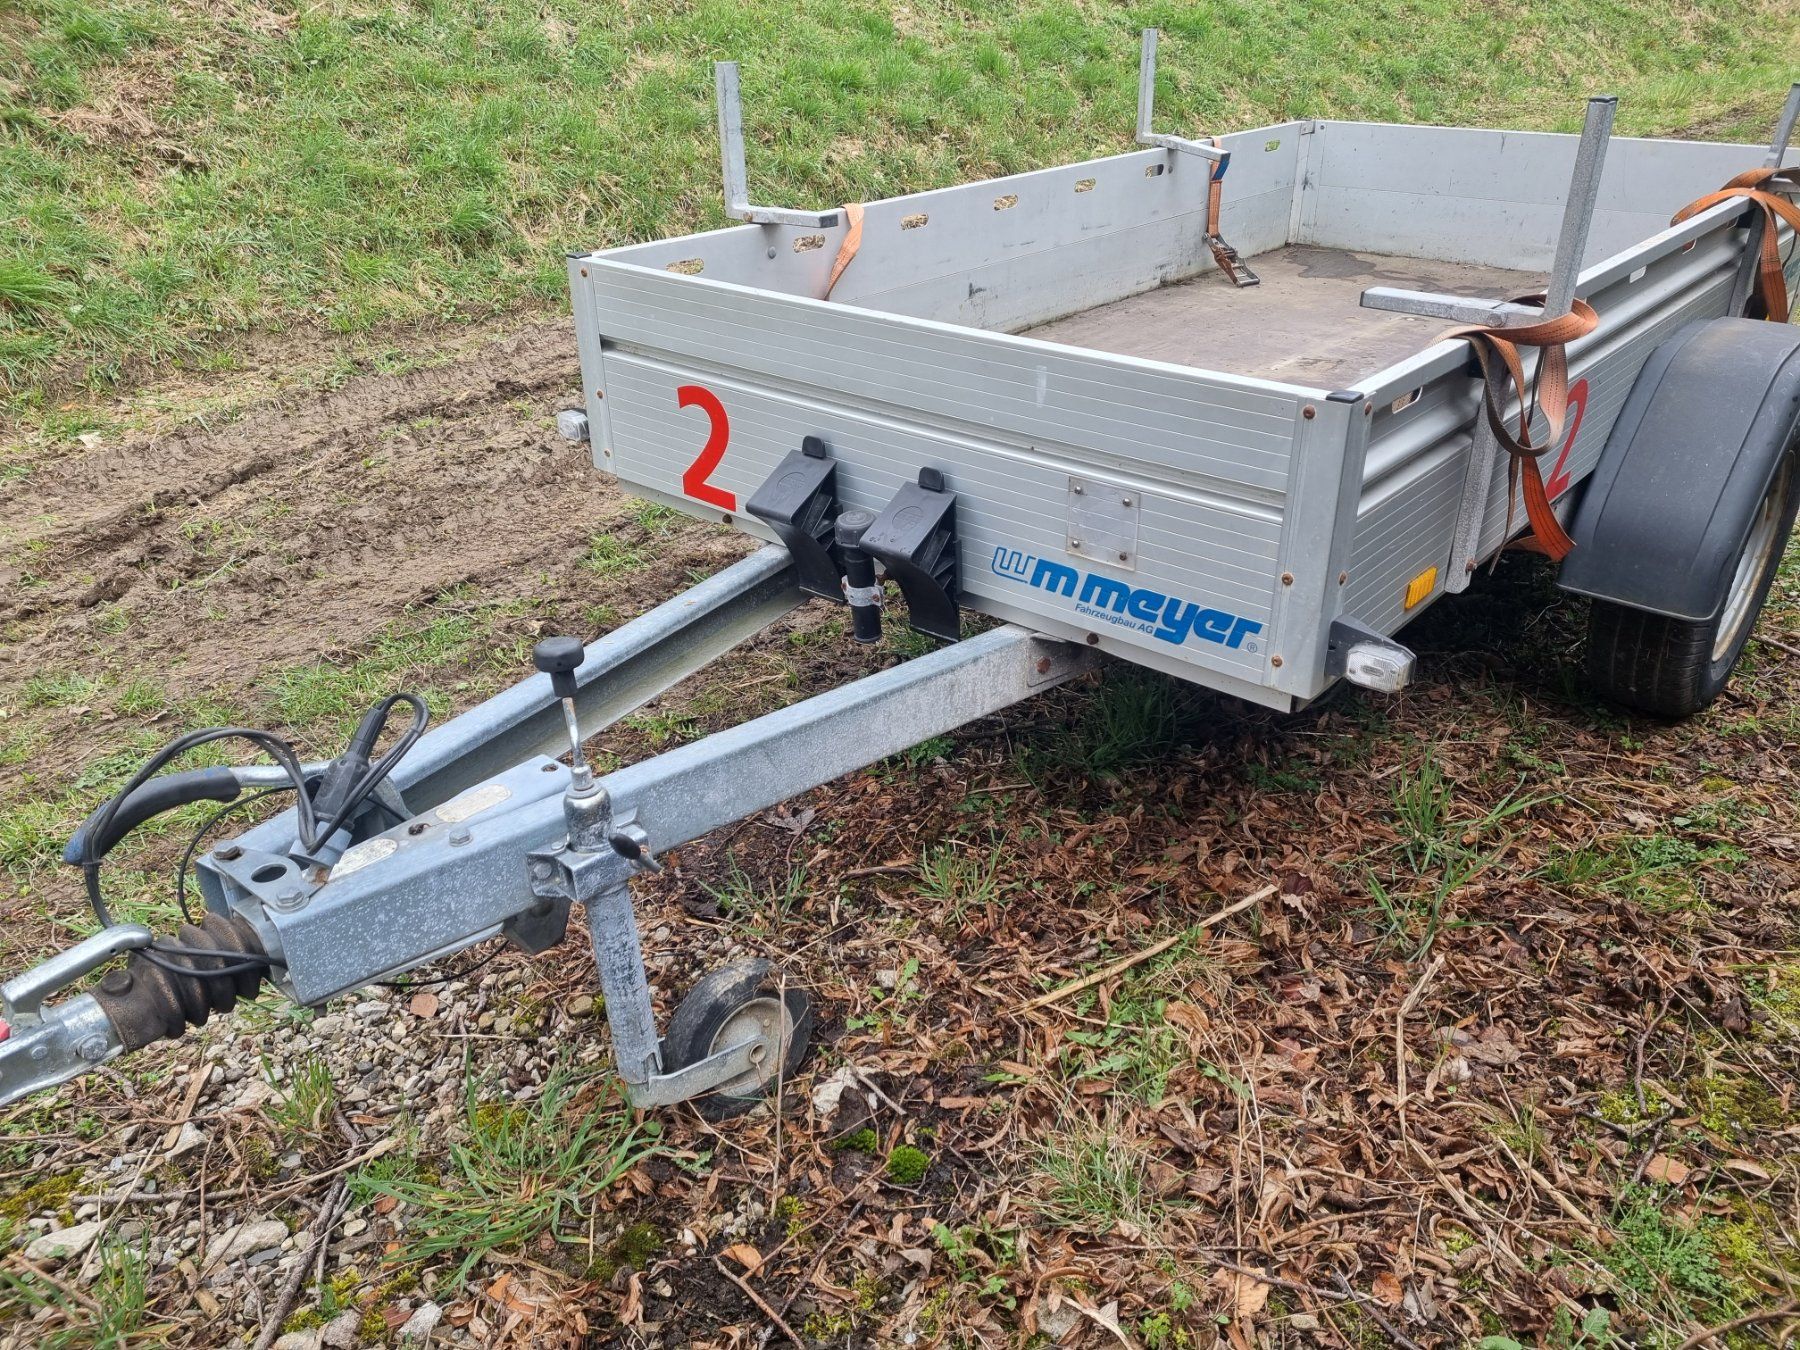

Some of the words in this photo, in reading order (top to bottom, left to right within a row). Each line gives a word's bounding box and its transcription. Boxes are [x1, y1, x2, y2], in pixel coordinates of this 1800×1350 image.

[677, 385, 736, 512] 2
[1545, 378, 1588, 501] 2
[1074, 603, 1137, 629] Fahrzeugbau
[1137, 622, 1155, 635] AG
